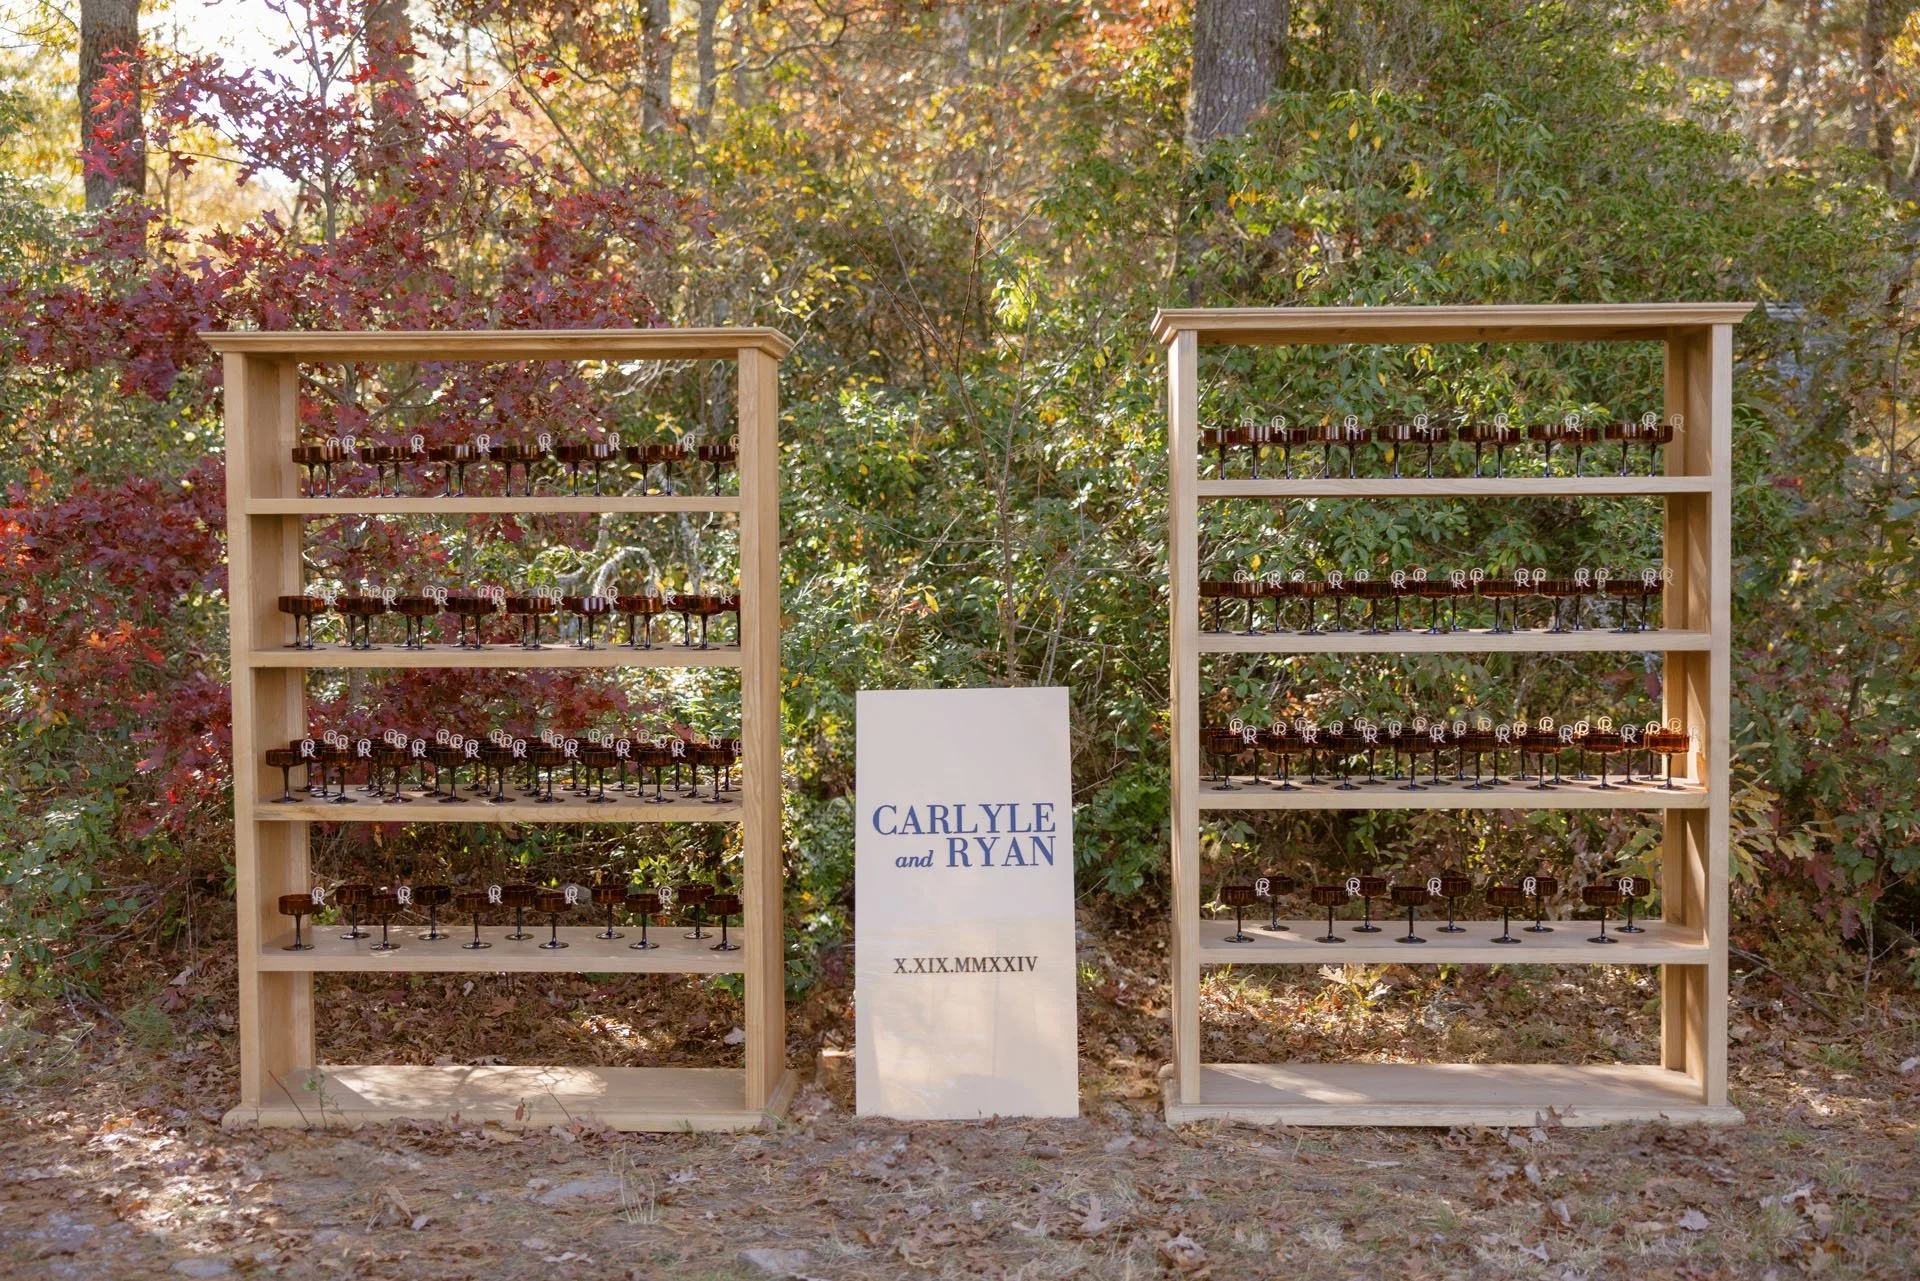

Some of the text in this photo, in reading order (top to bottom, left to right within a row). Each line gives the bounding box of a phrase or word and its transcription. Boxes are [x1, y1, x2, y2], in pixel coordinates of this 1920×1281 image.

[873, 803, 1055, 835] CARLYLE
[895, 837, 1056, 868] and RYAN
[894, 956, 1038, 973] X.XIX.MMXXIV
